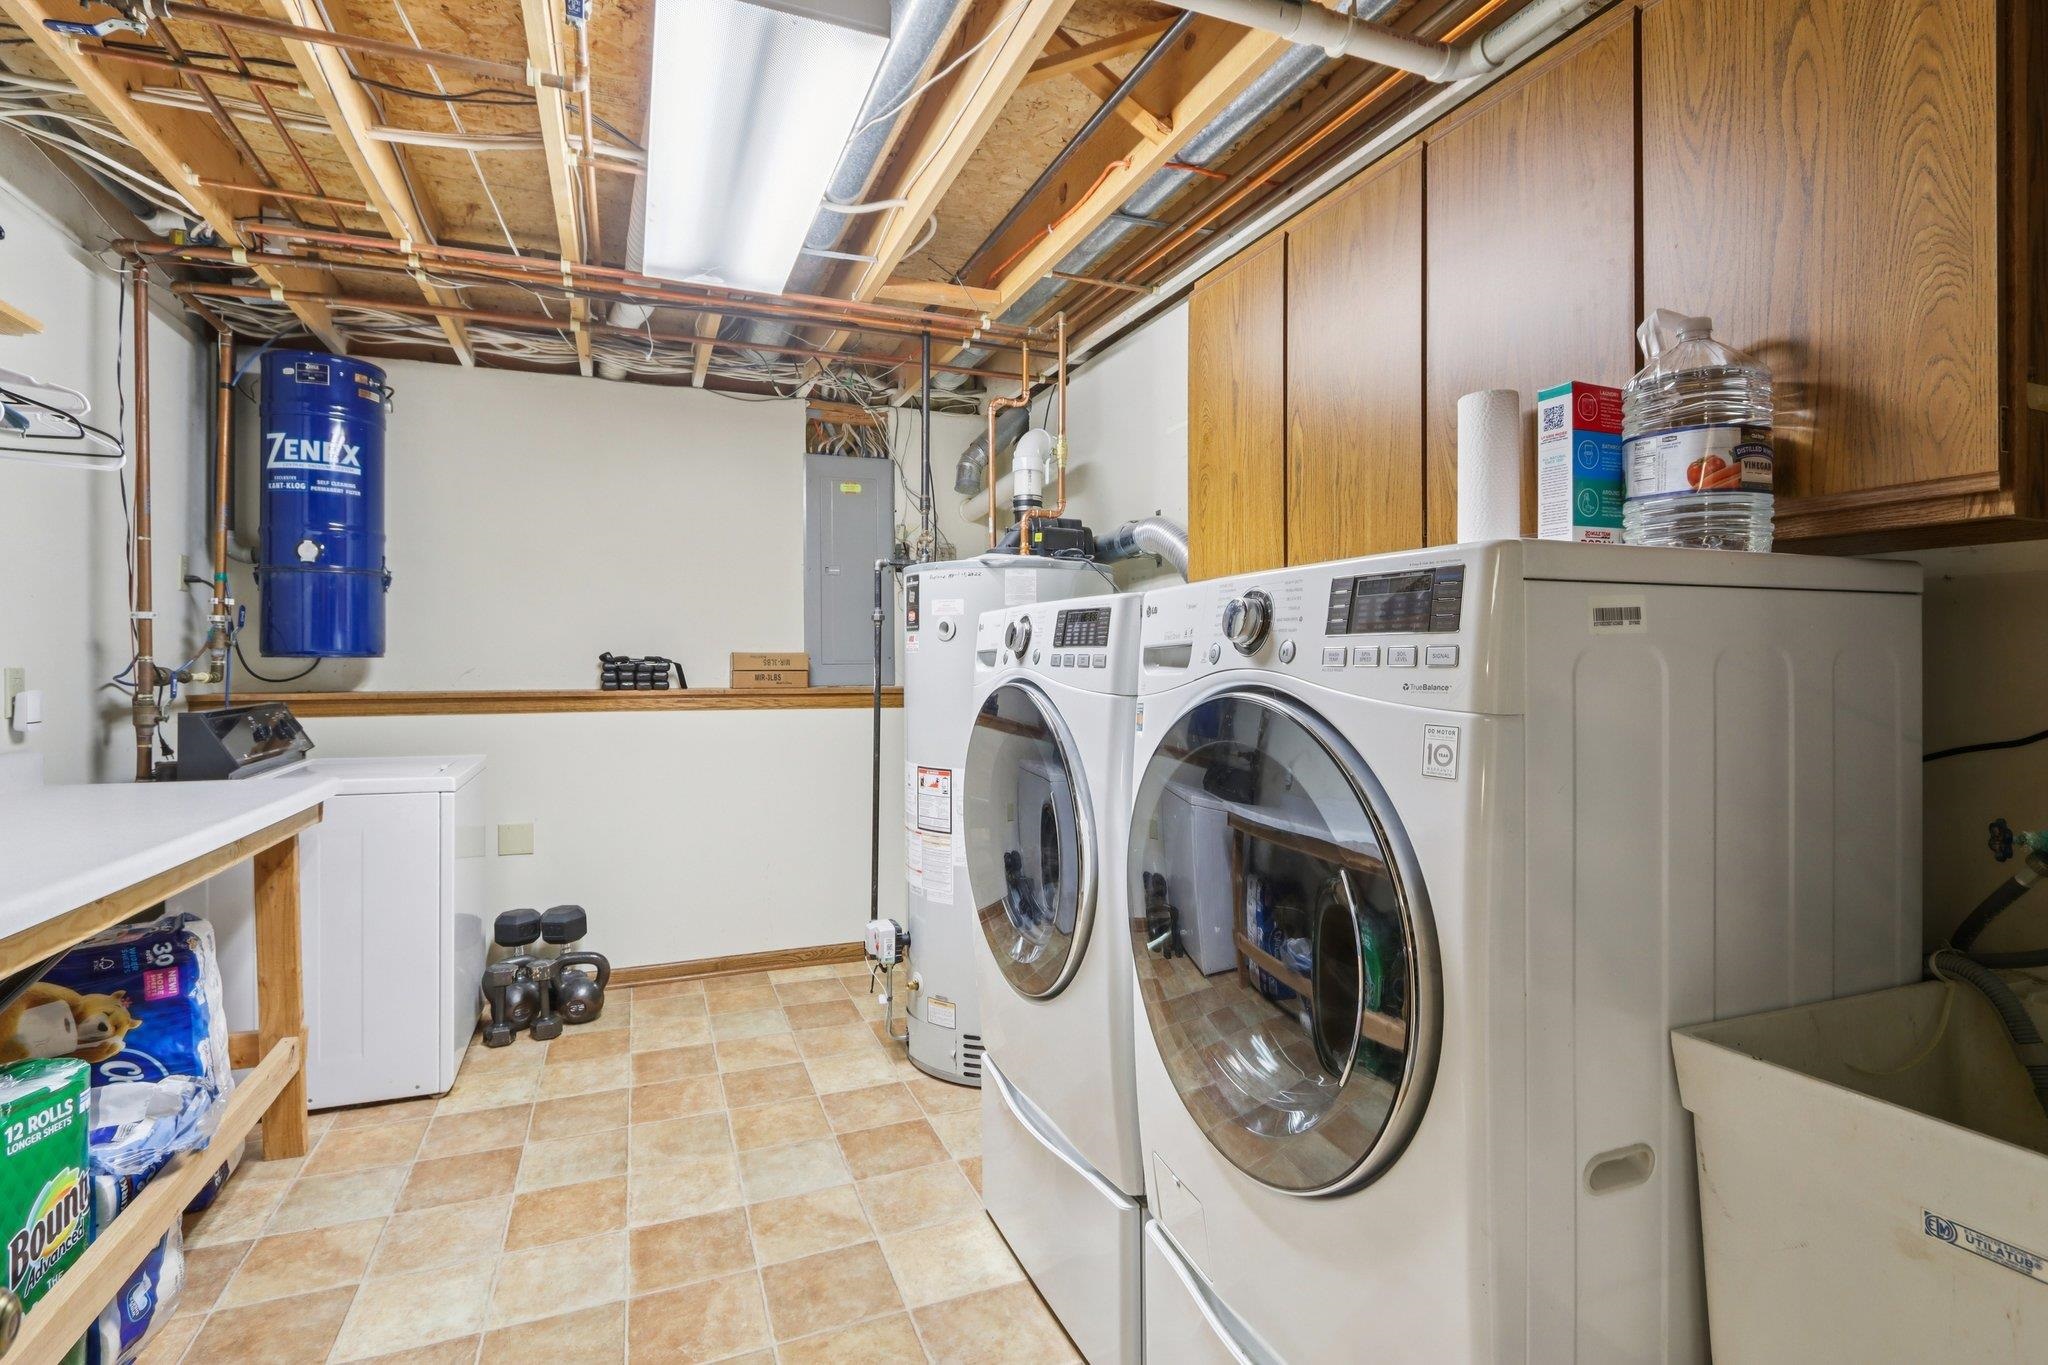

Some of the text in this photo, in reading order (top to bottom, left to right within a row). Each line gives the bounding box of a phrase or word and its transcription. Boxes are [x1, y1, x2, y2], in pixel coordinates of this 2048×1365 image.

[1744, 461, 1771, 471] VINEGAR
[152, 942, 175, 966] 30
[4, 1098, 74, 1144] 12 ROLLS
[7, 1116, 72, 1156] LONGER SHEETS
[25, 1217, 85, 1298] Advanced
